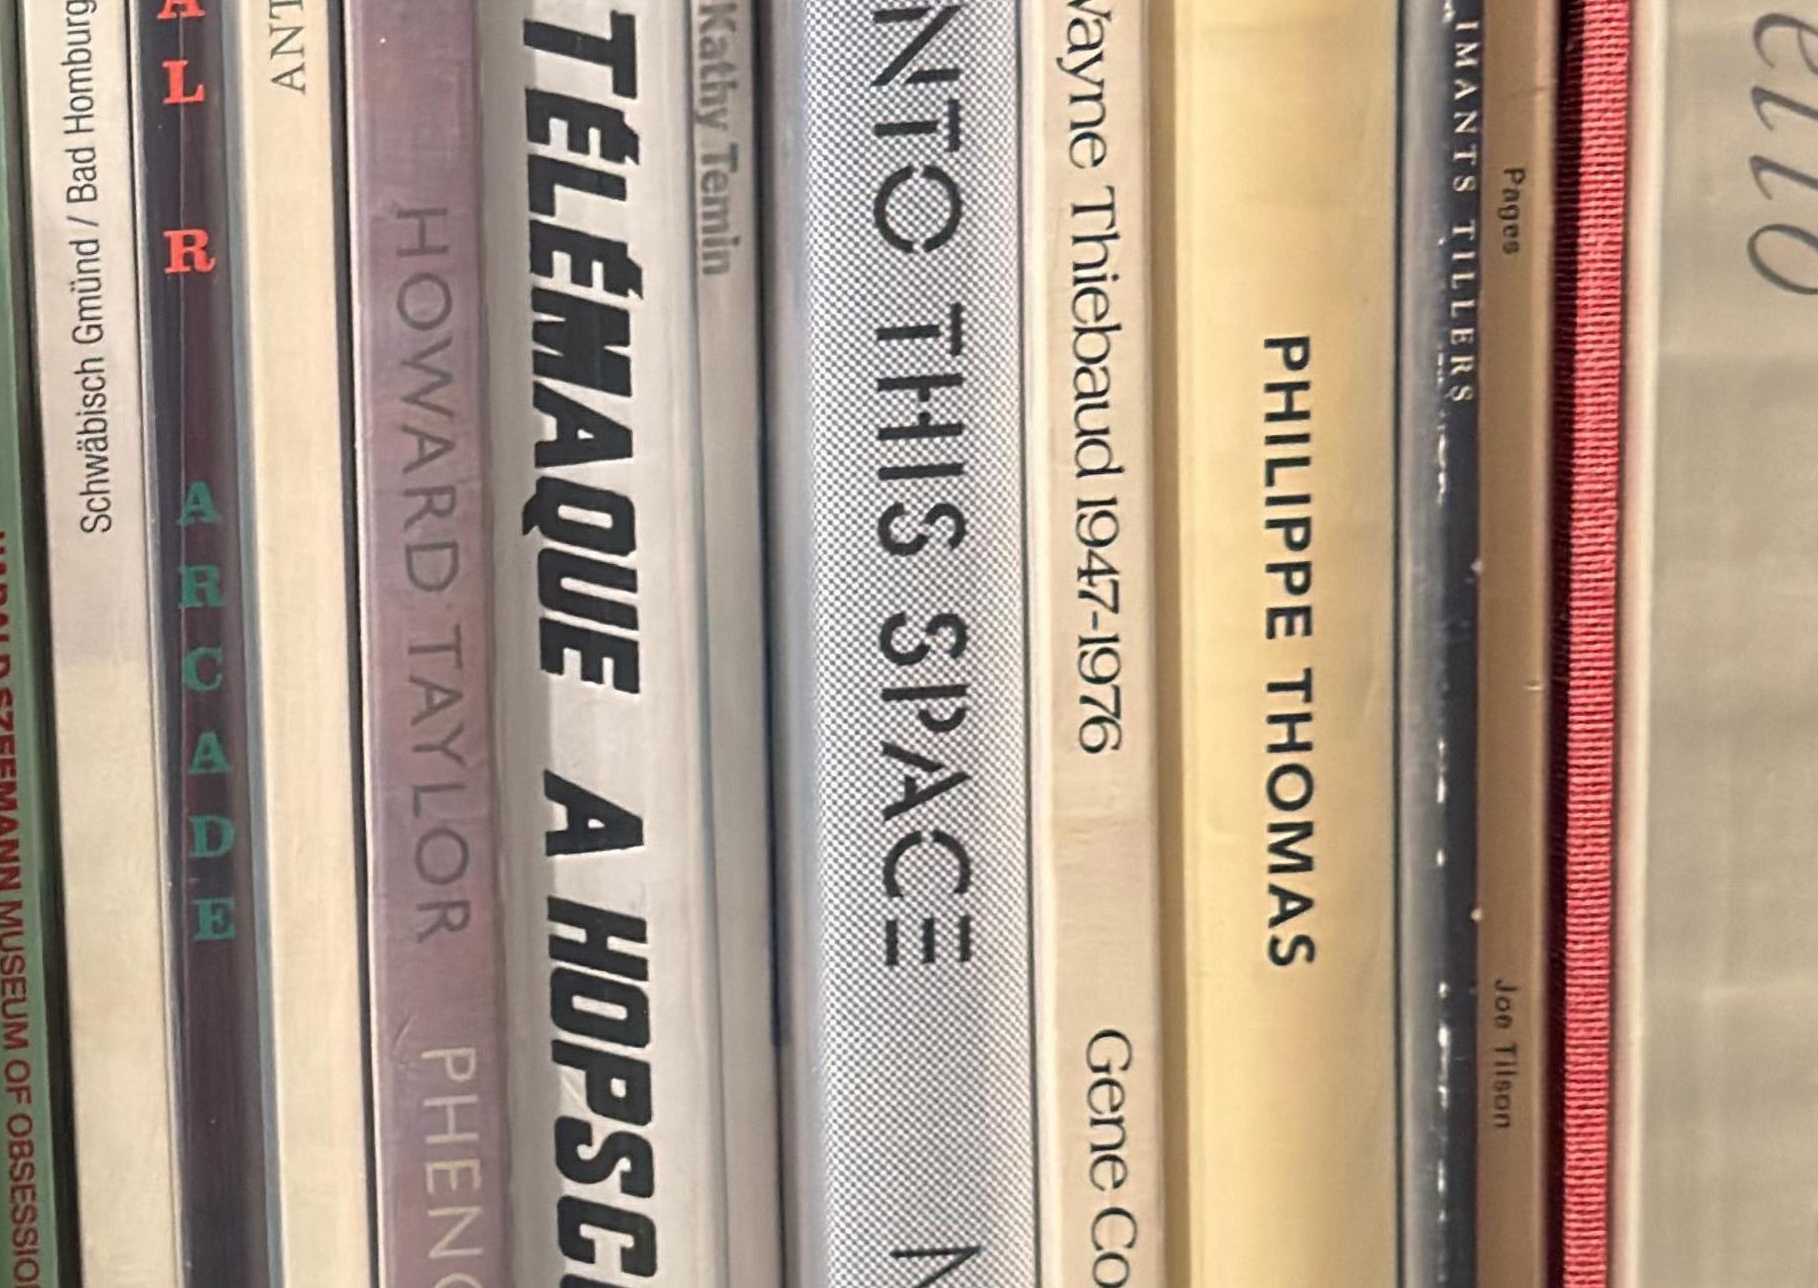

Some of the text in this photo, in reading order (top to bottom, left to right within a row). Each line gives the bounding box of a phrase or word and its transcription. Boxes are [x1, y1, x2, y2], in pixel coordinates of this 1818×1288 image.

[67, 146, 99, 210] Bad
[163, 229, 216, 276] R
[695, 2, 741, 280] Kathy Temin
[1447, 19, 1481, 404] IMANTS TILLERS
[1496, 167, 1527, 256] Pages
[70, 238, 104, 351] Gmünd
[394, 205, 461, 594] HOWARD
[520, 9, 645, 697] TÉLÉMAQUE
[1068, 184, 1125, 481] Thiebaud
[74, 357, 114, 536] Schwäbisch
[874, 301, 968, 558] THIS
[176, 479, 237, 943] ARCADE
[1076, 492, 1126, 757] 1947-1976
[1261, 333, 1317, 969] PHILIPPE THOMAS
[406, 623, 474, 945] TAYLOR
[543, 768, 646, 858] A
[877, 610, 974, 968] SPACE
[3, 1056, 33, 1106] OF
[1083, 1028, 1134, 1194] Gene
[1493, 976, 1520, 1131] Joe Tilson
